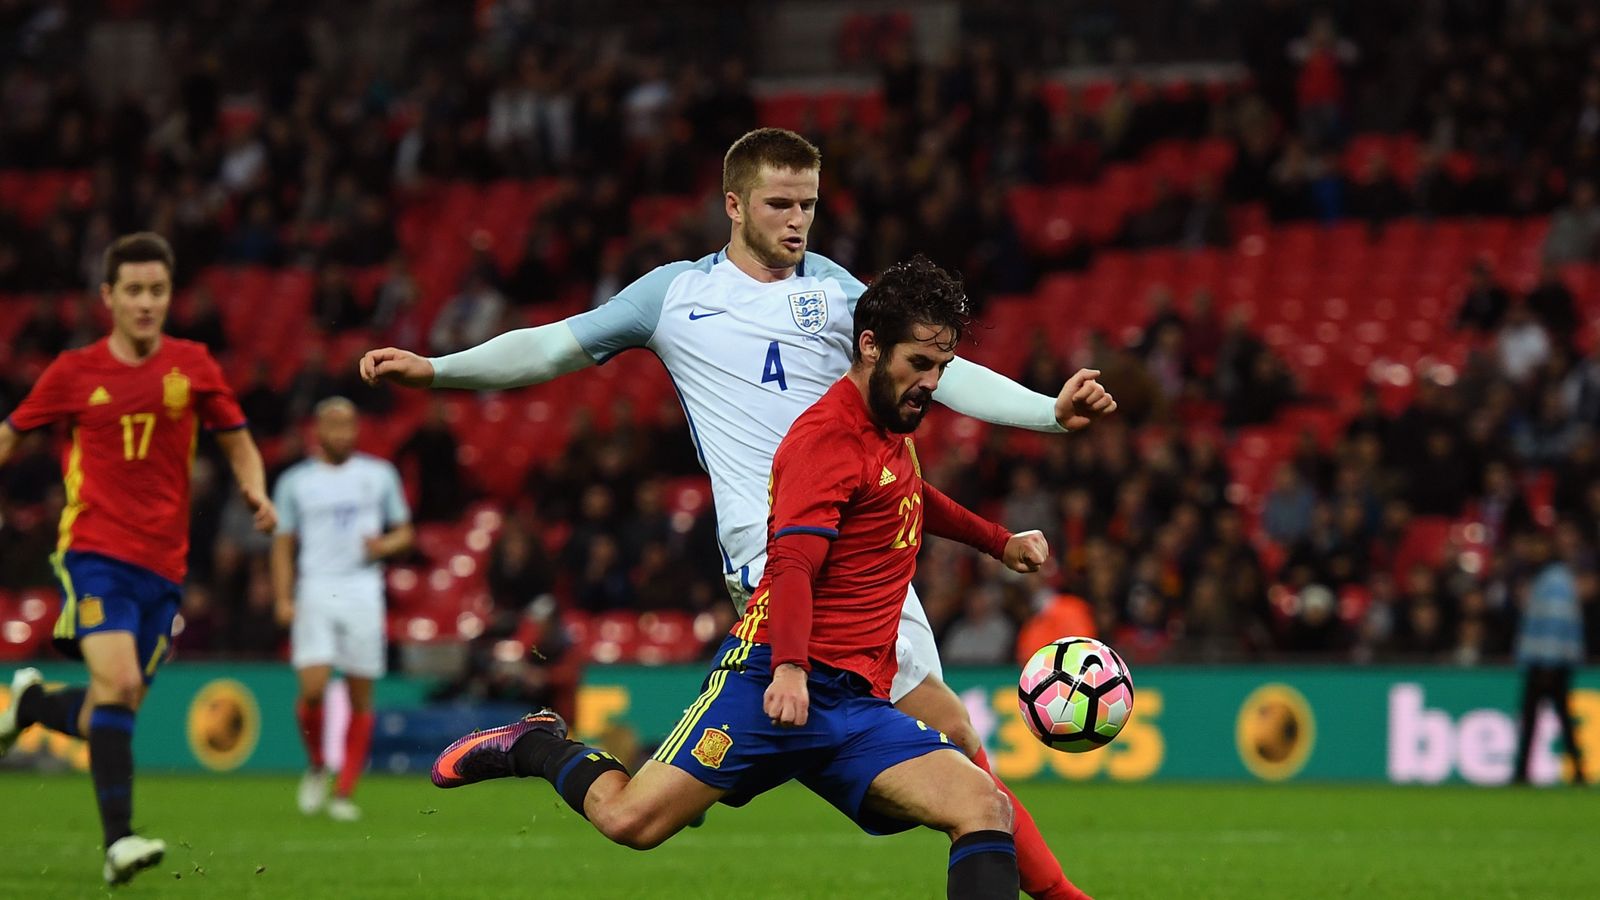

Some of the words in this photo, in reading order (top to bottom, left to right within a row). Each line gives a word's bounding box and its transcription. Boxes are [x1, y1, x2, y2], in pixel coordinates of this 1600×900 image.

[761, 341, 788, 391] 4
[120, 413, 155, 460] 17
[890, 492, 921, 549] 22
